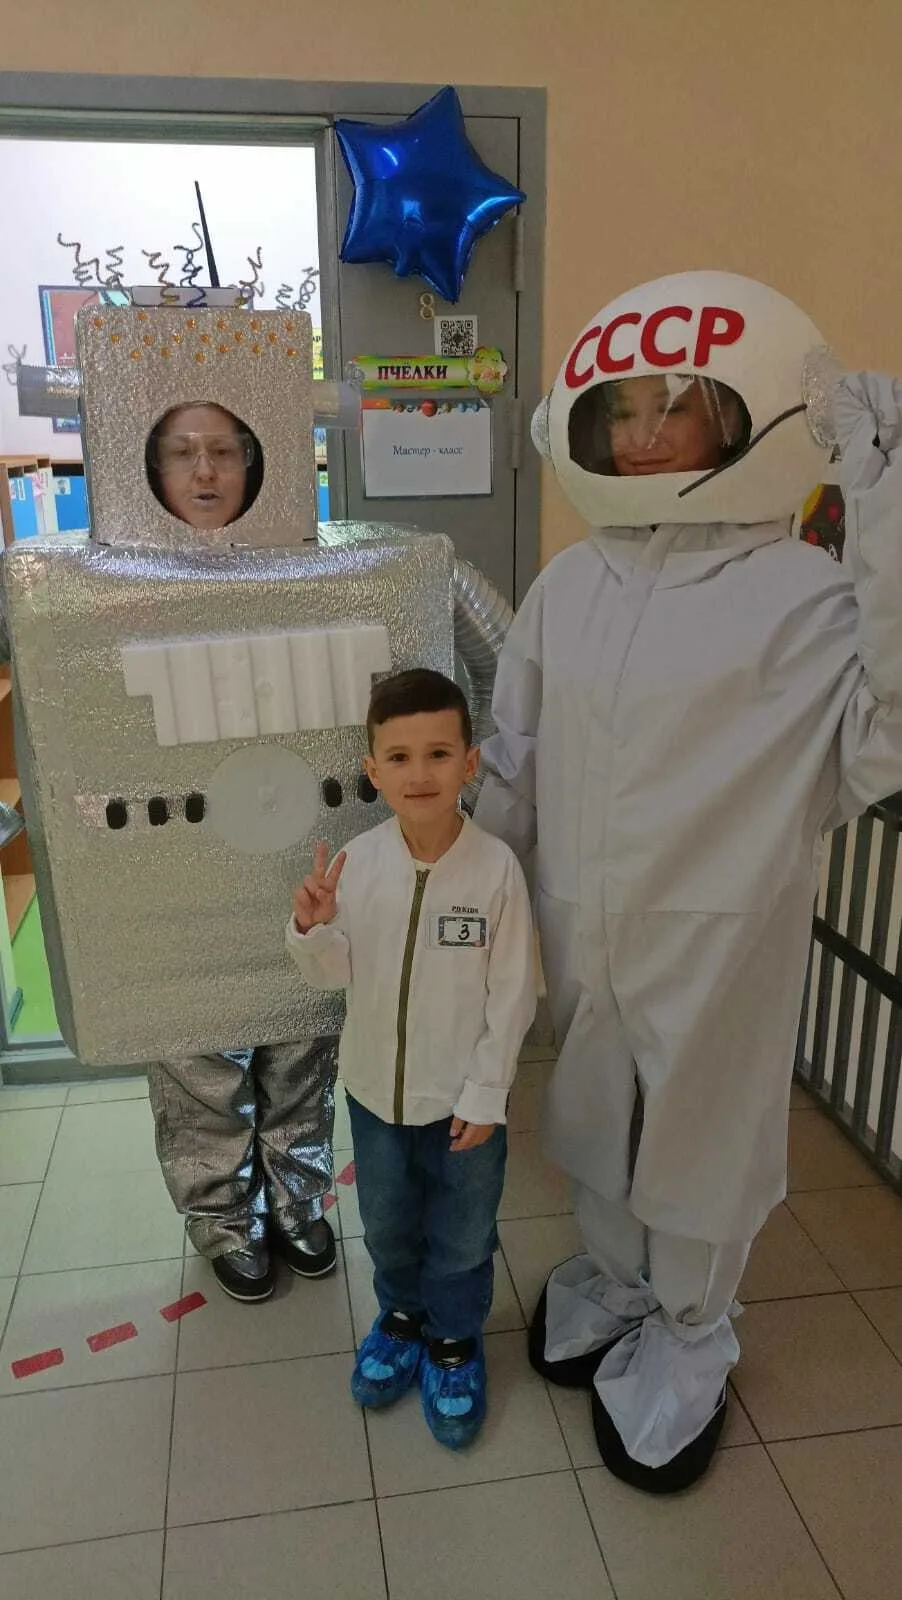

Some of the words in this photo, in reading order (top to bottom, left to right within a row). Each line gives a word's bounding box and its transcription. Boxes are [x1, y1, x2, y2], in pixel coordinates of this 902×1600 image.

[420, 293, 434, 320] 8
[565, 306, 745, 389] СССР
[377, 361, 448, 380] ПЧЁЛКИ
[392, 445, 430, 459] Мастер
[439, 447, 464, 456] класс
[457, 924, 470, 941] 3
